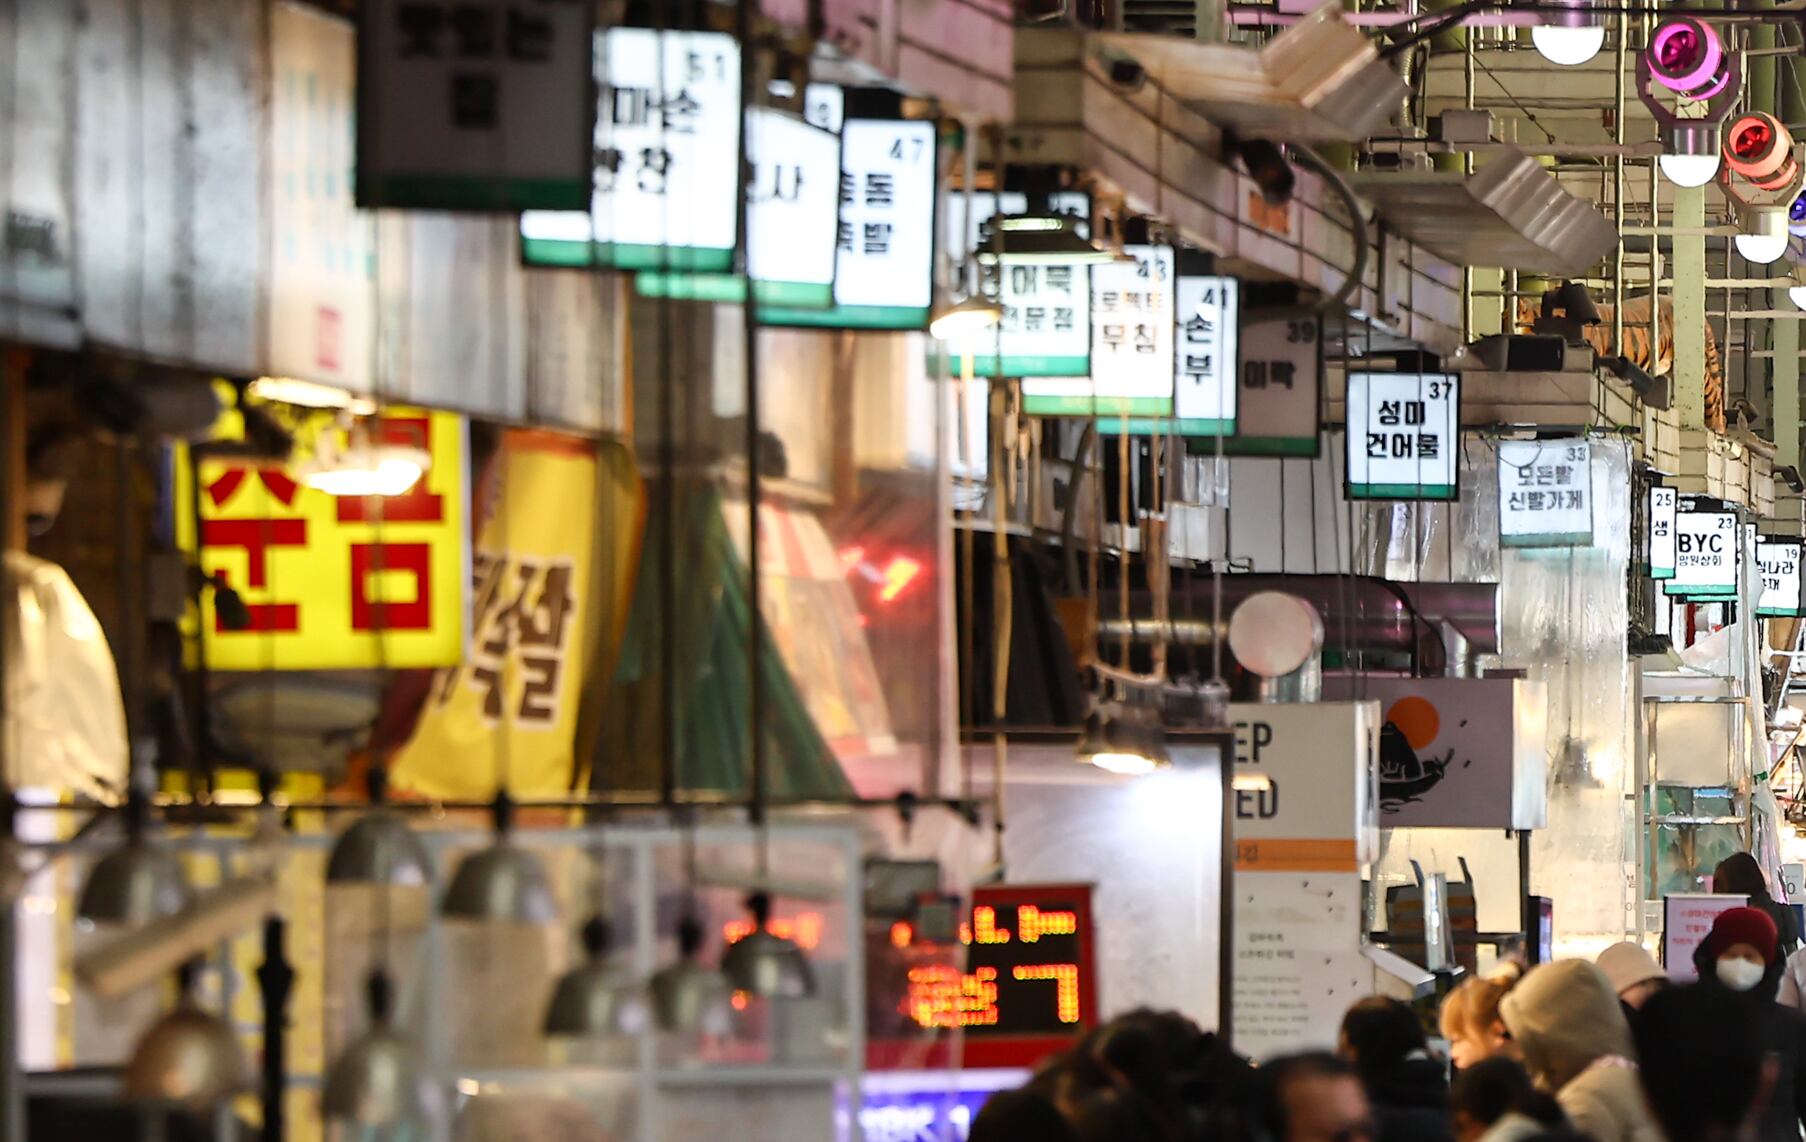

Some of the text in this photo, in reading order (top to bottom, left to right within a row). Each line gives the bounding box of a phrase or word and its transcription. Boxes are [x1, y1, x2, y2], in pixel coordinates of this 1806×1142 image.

[688, 52, 726, 84] 51
[889, 137, 924, 166] 47
[1137, 259, 1167, 281] 43
[1102, 323, 1157, 354] 무침
[1428, 382, 1453, 401] 37
[1378, 400, 1426, 426] 성미
[1366, 432, 1440, 460] 건어물
[1566, 447, 1587, 462] 33
[1508, 490, 1584, 512] 신발가게
[1655, 493, 1673, 507] 25
[1717, 517, 1733, 529] 23
[1677, 533, 1723, 553] BYC
[1678, 555, 1722, 567] 망원상회
[1784, 548, 1798, 560] 19
